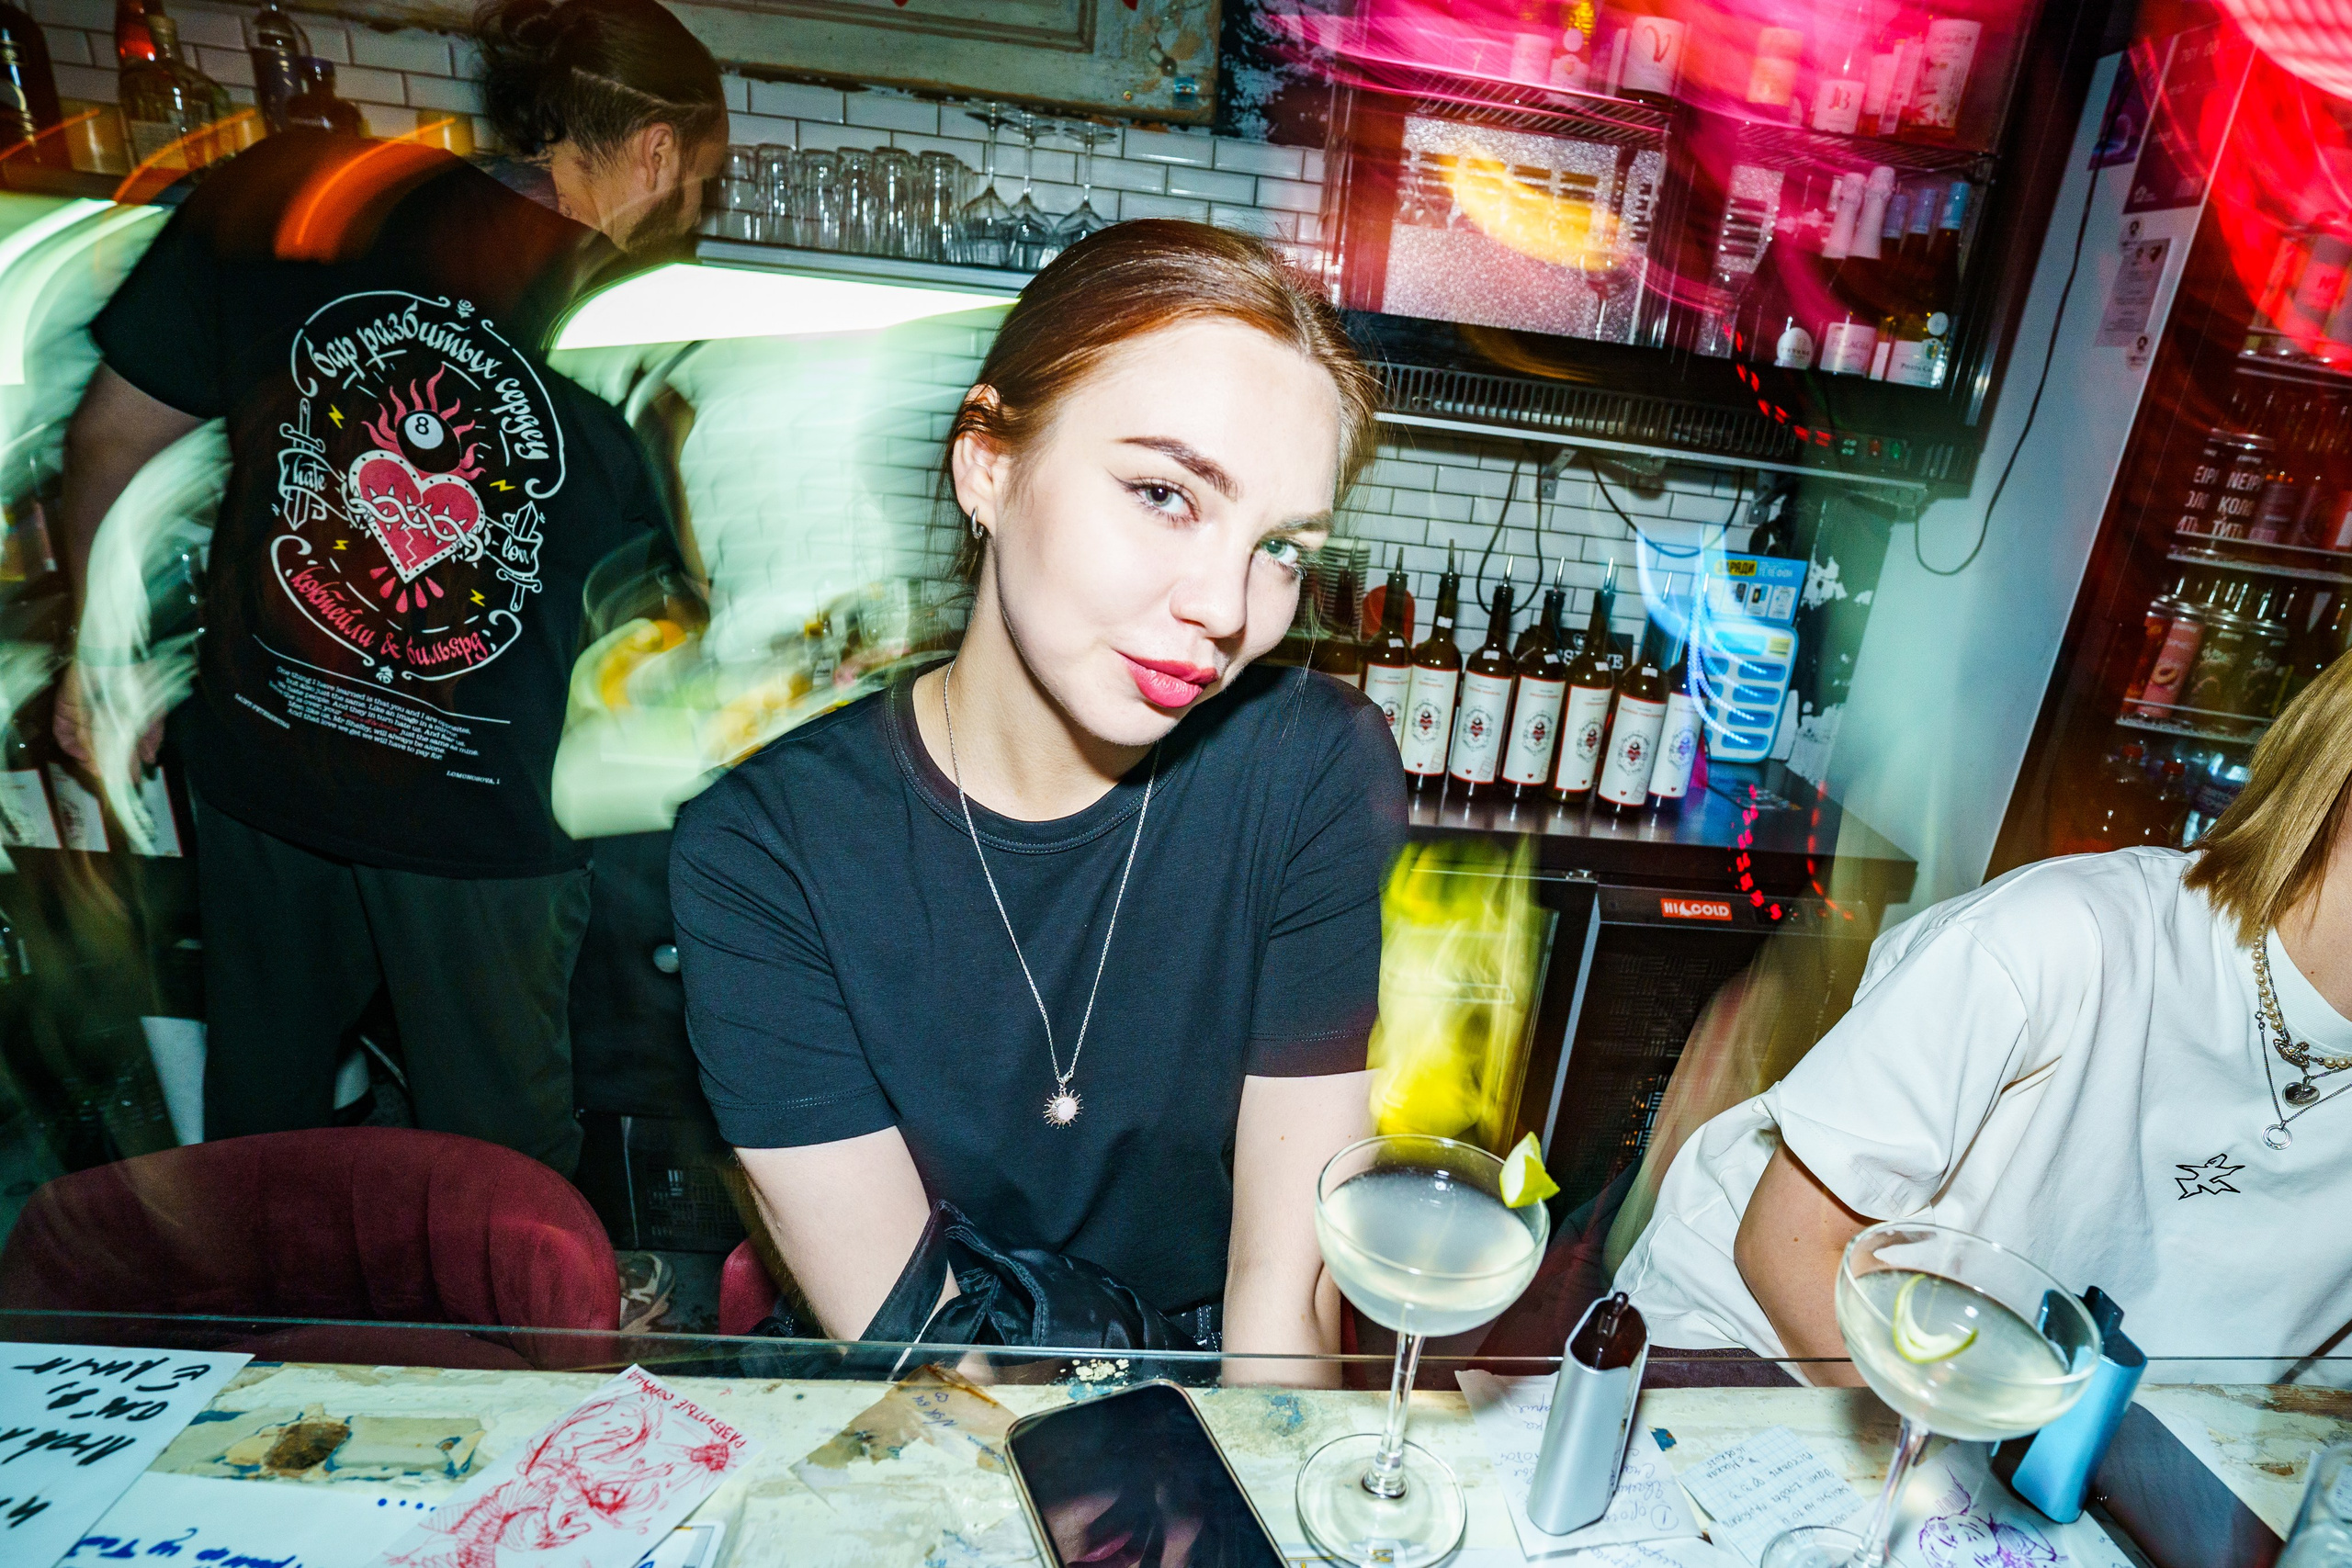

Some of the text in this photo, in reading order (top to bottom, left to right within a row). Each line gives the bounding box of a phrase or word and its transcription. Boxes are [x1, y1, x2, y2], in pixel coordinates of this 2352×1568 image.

[305, 302, 549, 460] бар разбитых сердец
[415, 417, 429, 435] 8
[292, 454, 329, 492] hate
[289, 566, 486, 665] коктейли & бильярд
[331, 693, 344, 701] the
[368, 704, 385, 714] Like
[396, 712, 419, 724] image
[335, 686, 366, 701] learned
[374, 698, 390, 708] that
[390, 703, 405, 713] you
[405, 708, 421, 718] and
[425, 715, 438, 723] are
[332, 701, 348, 711] And
[349, 705, 367, 716] they
[377, 714, 393, 724] turn
[394, 719, 411, 729] hate
[424, 729, 440, 739] And
[441, 734, 455, 742] fear
[333, 715, 345, 724] Mr
[345, 719, 372, 733] Shelby,
[373, 728, 388, 737] will
[388, 733, 413, 745] always
[413, 739, 423, 748] be
[349, 728, 361, 737] get
[362, 732, 373, 740] we
[374, 736, 388, 744] will
[388, 739, 406, 750] have
[415, 747, 430, 757] pay
[416, 733, 429, 742] the
[429, 738, 449, 748] same
[669, 1399, 748, 1450] РАЗБИТЫЕ
[1616, 1480, 1664, 1500] Евгени
[1600, 1499, 1679, 1531] Дорого
